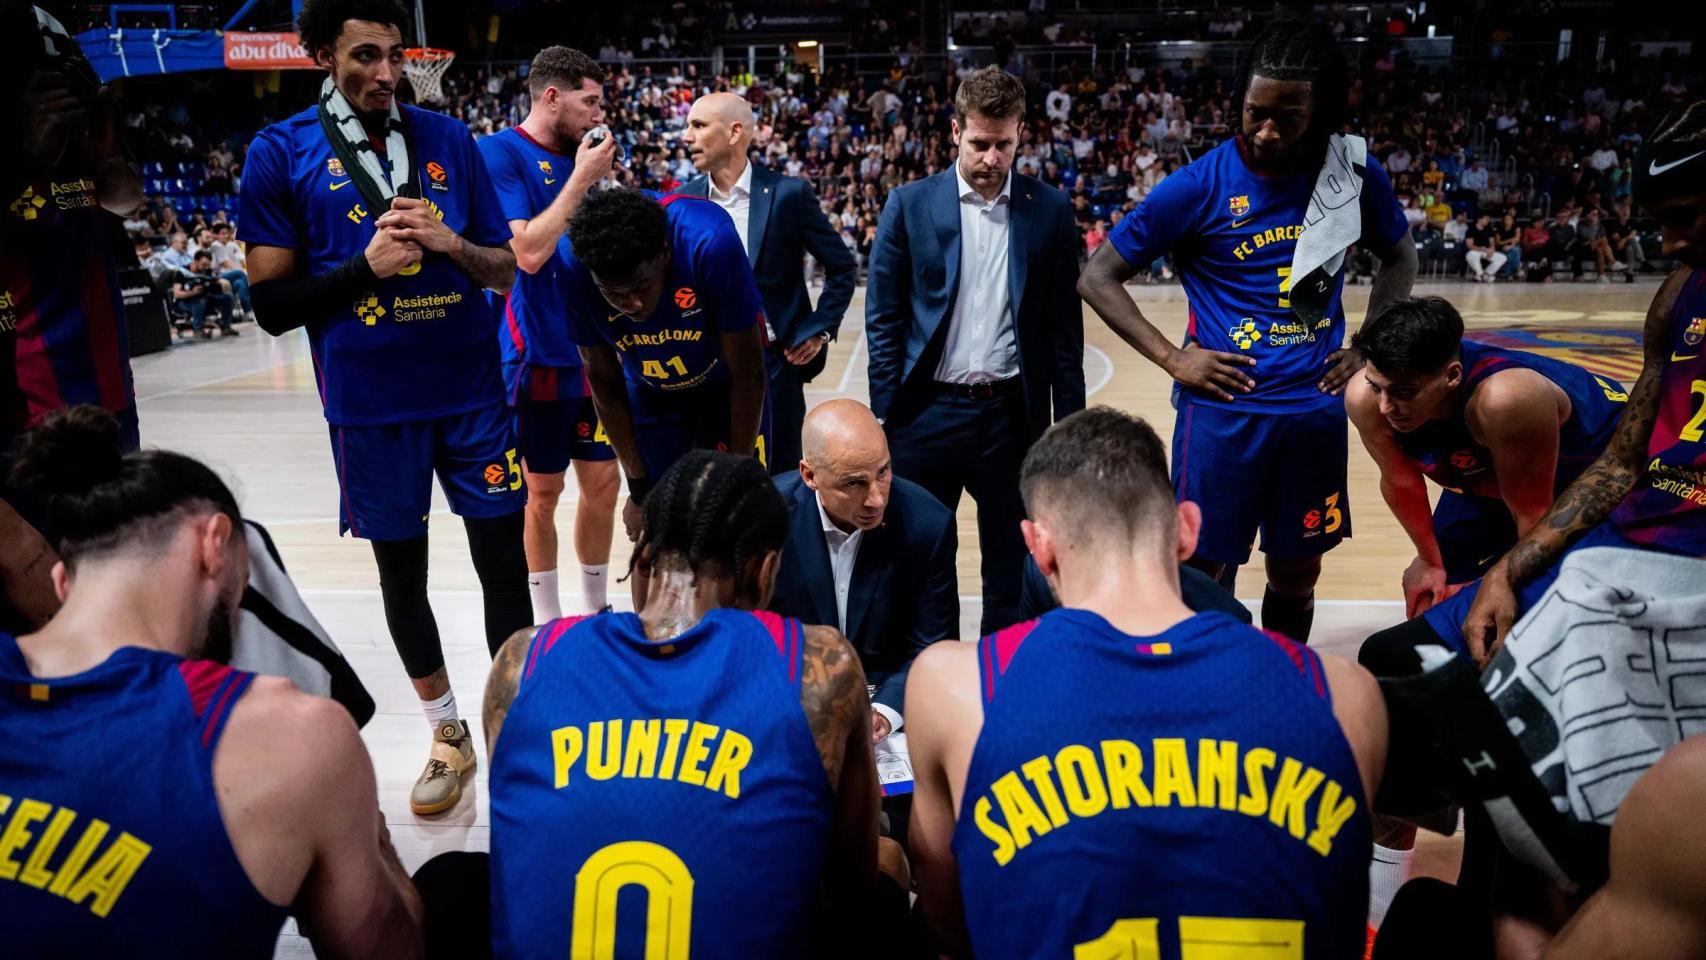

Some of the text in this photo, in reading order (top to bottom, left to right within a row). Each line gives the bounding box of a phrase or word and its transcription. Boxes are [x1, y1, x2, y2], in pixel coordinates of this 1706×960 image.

[229, 42, 308, 60] abu dha
[347, 203, 369, 224] FC
[1233, 225, 1304, 261] FC BARCE
[394, 291, 462, 309] Assistència
[394, 306, 446, 323] Sanitària
[616, 329, 702, 352] FC ARCELONA
[642, 355, 689, 380] 41
[505, 448, 523, 491] 5
[755, 434, 768, 471] 1
[1325, 491, 1342, 534] 3
[551, 718, 753, 799] PUNTER
[974, 738, 1357, 867] SATORANSKY
[0, 794, 152, 918] ELIA
